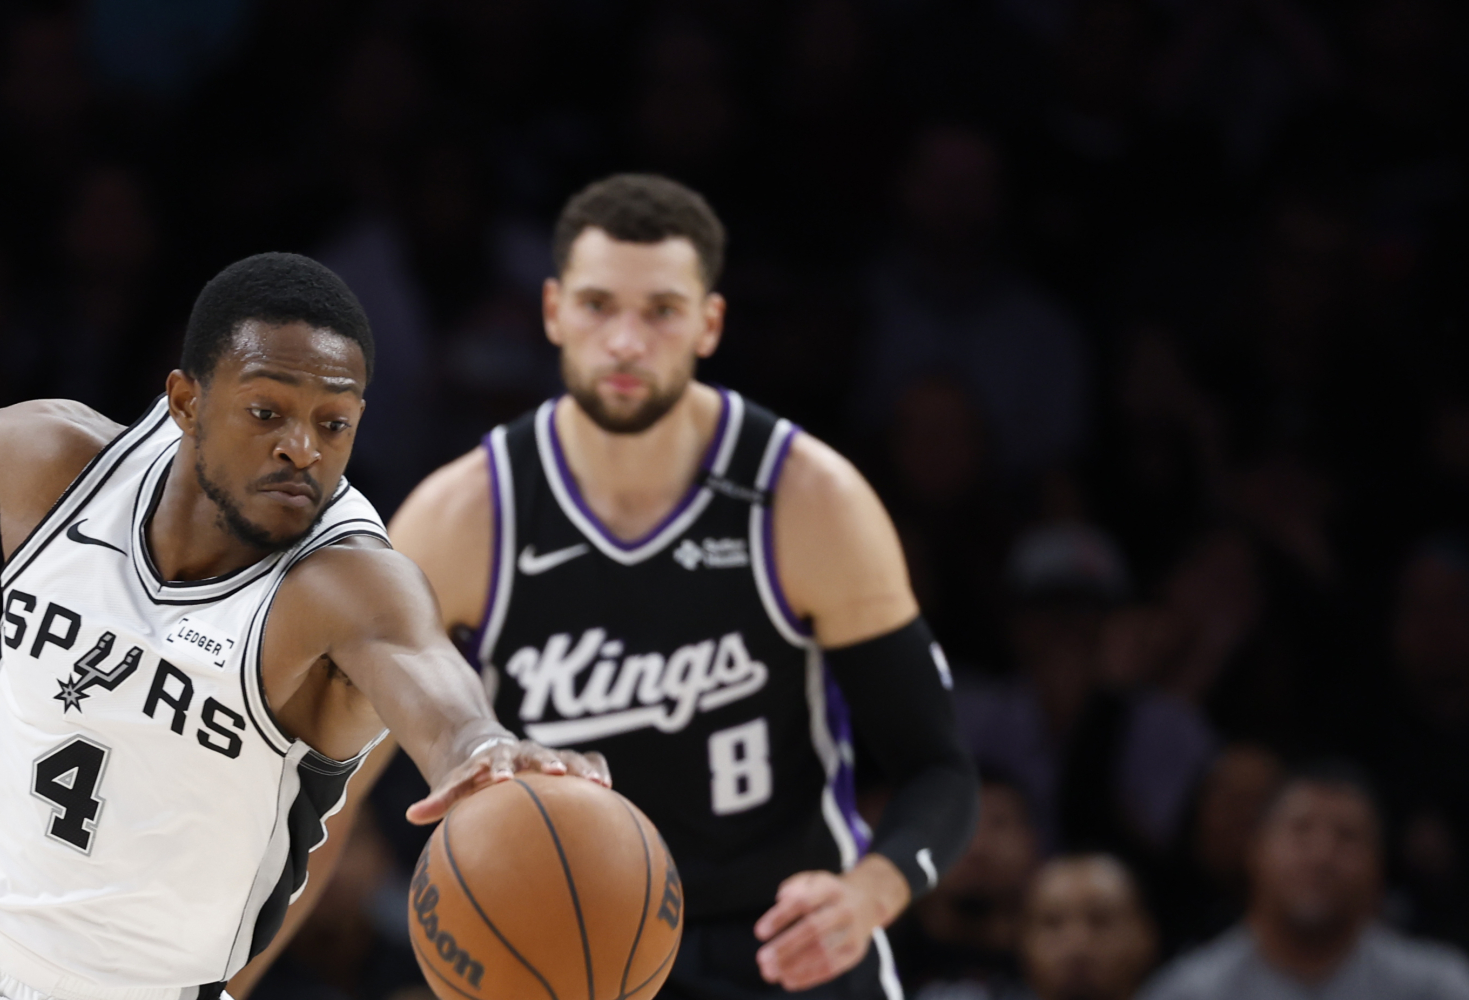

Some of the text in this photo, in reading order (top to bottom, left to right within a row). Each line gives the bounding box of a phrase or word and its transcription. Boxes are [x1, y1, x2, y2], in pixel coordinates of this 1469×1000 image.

[3, 588, 247, 760] SPURS
[177, 626, 223, 656] LEDGER
[506, 627, 768, 748] Kings
[30, 733, 112, 857] 4
[708, 717, 773, 816] 8
